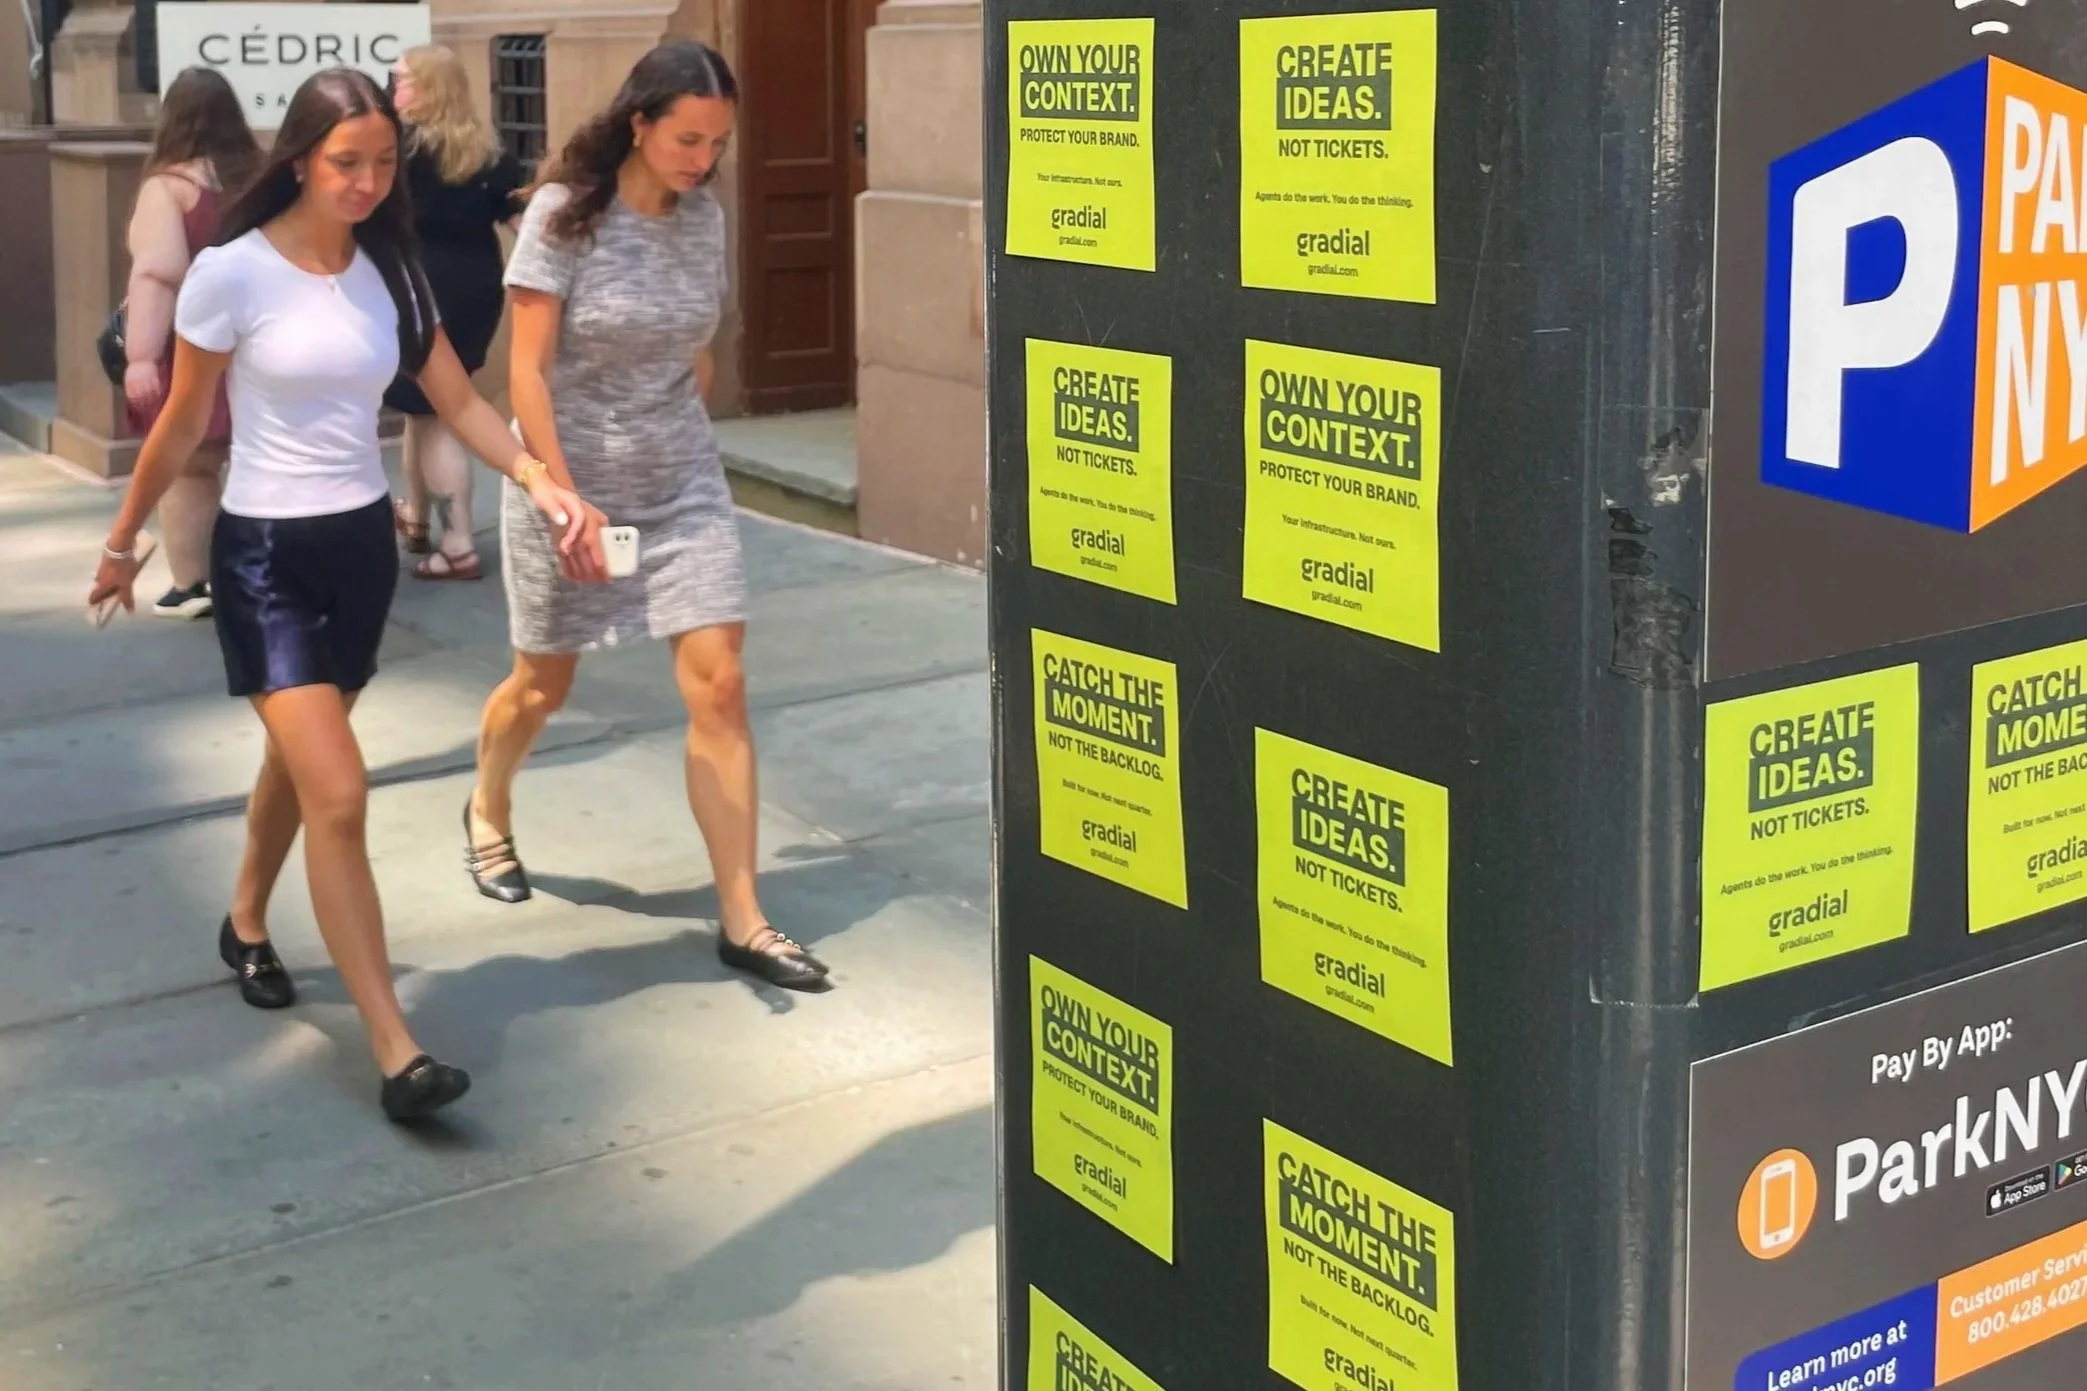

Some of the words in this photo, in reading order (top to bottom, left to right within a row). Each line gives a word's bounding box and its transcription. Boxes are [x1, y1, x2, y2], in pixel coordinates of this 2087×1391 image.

[198, 24, 399, 65] CÉDRIC
[1020, 44, 1071, 73] OWN
[1077, 44, 1140, 73] YOUR
[1277, 42, 1392, 77] CREATE
[256, 93, 287, 107] SA
[1025, 81, 1134, 112] CONTEXT.
[1285, 85, 1381, 120] IDEAS.
[1021, 128, 1065, 143] PROTECT
[1068, 131, 1097, 145] YOUR
[1100, 133, 1139, 147] BRAND.
[1279, 139, 1310, 157] NOT
[1314, 140, 1388, 159] TICKETS.
[1095, 178, 1106, 186] Not
[1998, 96, 2087, 254] PA
[1052, 205, 1106, 229] gradial
[1256, 192, 1281, 202] Agents
[1283, 193, 1292, 201] do
[1294, 193, 1306, 202] the
[1309, 194, 1330, 204] work.
[1332, 195, 1347, 204] You
[1349, 195, 1359, 204] do
[1361, 195, 1375, 205] the
[1378, 196, 1413, 208] thinking.
[1059, 236, 1097, 247] gradial.com
[1297, 228, 1369, 256] gradial
[1308, 264, 1358, 277] gradial.com
[1785, 136, 1958, 469] P
[1054, 366, 1139, 404] CREATE
[1260, 369, 1328, 411] OWN
[1337, 381, 1421, 426] YOUR
[1990, 279, 2087, 487] NY
[1061, 402, 1132, 443] IDEAS.
[1267, 410, 1414, 469] CONTEXT.
[1057, 446, 1081, 464] NOT
[1083, 451, 1137, 476] TICKETS.
[1260, 460, 1320, 486] PROTECT
[1324, 473, 1362, 495] YOUR
[1366, 483, 1420, 509] BRAND.
[1071, 528, 1125, 556] gradial
[1282, 514, 1299, 526] Your
[1301, 517, 1357, 540] infrastructure.
[1359, 532, 1374, 545] Not
[1375, 538, 1396, 549] ours.
[1081, 556, 1118, 572] gradial.com
[1301, 558, 1373, 594] gradial
[1312, 590, 1362, 611] gradial.com
[1044, 654, 1113, 696] CATCH
[1120, 672, 1163, 708] THE
[1987, 665, 2081, 718] CATCH
[1053, 689, 1156, 745] MOMENT.
[1750, 701, 1874, 759] CREATE
[1997, 704, 2087, 756] MOME
[1049, 730, 1072, 749] NOT
[1075, 739, 1098, 760] THE
[1101, 747, 1164, 781] BACKLOG.
[1759, 747, 1864, 800] IDEAS.
[1988, 770, 2021, 794] NOT
[2025, 762, 2054, 784] THE
[2058, 752, 2087, 776] BAC
[1292, 768, 1405, 830] CREATE
[1751, 815, 1788, 840] NOT
[1792, 797, 1869, 831] TICKETS.
[2003, 821, 2021, 834] Built
[2023, 818, 2034, 829] for
[2036, 814, 2052, 826] now.
[2055, 809, 2068, 820] Not
[2069, 804, 2086, 816] next
[1082, 819, 1136, 853] gradial
[1301, 808, 1395, 873] IDEAS.
[2028, 836, 2087, 879] gradia
[1091, 848, 1129, 868] gradial.com
[1721, 878, 1752, 895] Agents
[1755, 875, 1766, 887] do
[1768, 871, 1782, 883] the
[1785, 866, 1808, 879] work.
[1811, 861, 1826, 873] You
[1828, 858, 1838, 868] do
[1840, 855, 1855, 866] the
[1857, 845, 1893, 862] thinking.
[1296, 855, 1326, 882] NOT
[1329, 868, 1403, 912] TICKETS.
[2037, 870, 2083, 893] gradial.com
[1273, 896, 1299, 914] Agents
[1301, 907, 1310, 918] do
[1311, 910, 1323, 925] the
[1326, 916, 1346, 935] work.
[1348, 926, 1362, 942] You
[1364, 932, 1375, 945] do
[1377, 937, 1390, 952] the
[1392, 944, 1426, 968] thinking.
[1769, 890, 1848, 938] gradial
[1779, 929, 1833, 952] gradial.com
[1315, 952, 1384, 997] gradial
[1326, 985, 1374, 1013] gradial.com
[1041, 985, 1090, 1033] OWN
[1097, 1011, 1159, 1068] YOUR
[1047, 1021, 1154, 1104] CONTEXT.
[1871, 1048, 1916, 1084] Pay
[1923, 1037, 1952, 1070] By
[1957, 1018, 2012, 1057] App:
[1043, 1060, 1086, 1097] PROTECT
[1089, 1086, 1117, 1113] YOUR
[1120, 1105, 1159, 1140] BRAND.
[1834, 1057, 2087, 1222] ParkNY
[1074, 1153, 1126, 1199] gradial
[1082, 1183, 1117, 1211] gradial.com
[2004, 1191, 2021, 1204] App
[2023, 1182, 2045, 1197] Store
[1278, 1152, 1370, 1228] CATCH
[1378, 1202, 1435, 1254] THE
[1291, 1193, 1425, 1295] MOMENT.
[1284, 1237, 1314, 1267] NOT
[1317, 1257, 1348, 1288] THE
[1351, 1276, 1434, 1337] BACKLOG.
[1950, 1269, 2040, 1318] Customer
[2044, 1243, 2087, 1280] Servi
[1301, 1295, 1318, 1313] Built
[1319, 1305, 1330, 1318] for
[1332, 1313, 1348, 1330] now.
[1351, 1325, 1365, 1340] Not
[1366, 1335, 1384, 1352] next
[1385, 1345, 1417, 1370] quarter.
[1768, 1355, 1825, 1391] Learn
[1831, 1333, 1882, 1369] more
[1886, 1320, 1908, 1342] at
